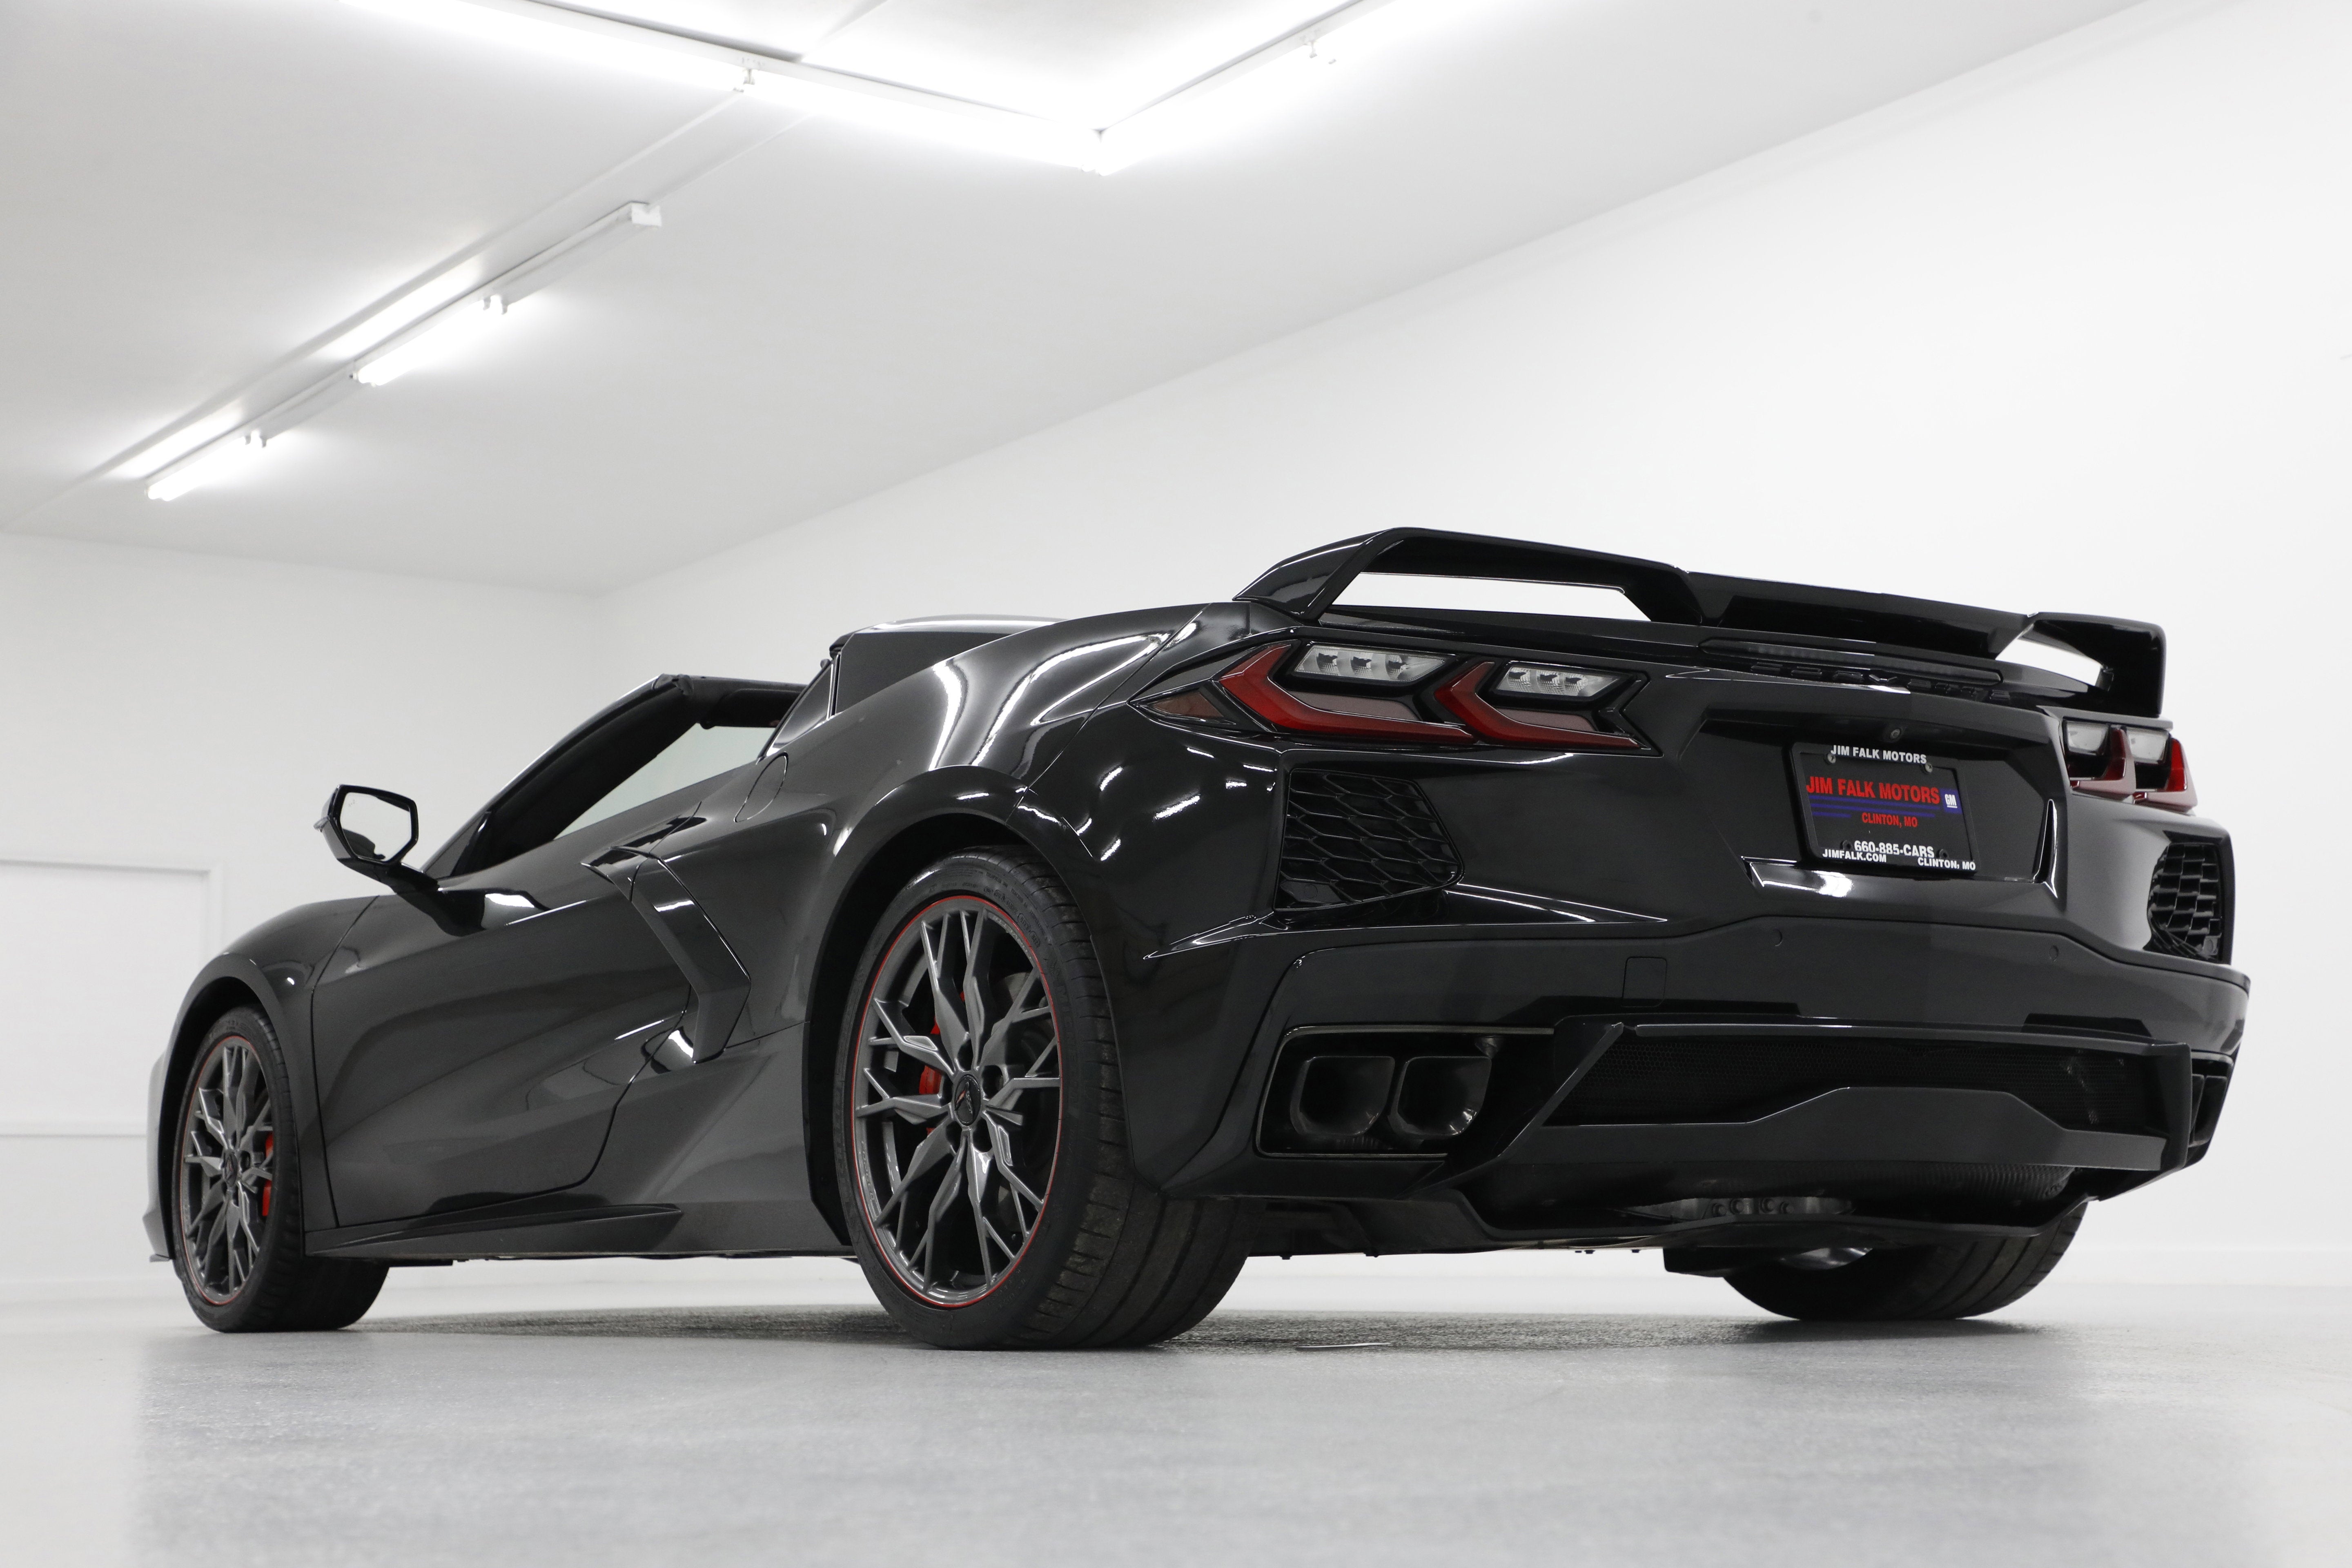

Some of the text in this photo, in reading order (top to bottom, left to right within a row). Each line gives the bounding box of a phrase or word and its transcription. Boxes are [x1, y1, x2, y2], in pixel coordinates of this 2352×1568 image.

[1831, 745, 1927, 764] JIM FALK MOTORS
[1806, 776, 1940, 804] JIM FALK MOTORS
[1944, 793, 1957, 806] GM
[1862, 813, 1918, 828] CLINTON, MO
[1822, 849, 1886, 863] JIMFALK.COM
[1854, 840, 1935, 858] 660-885-CARS
[1918, 857, 1976, 871] CLINTON, MO
